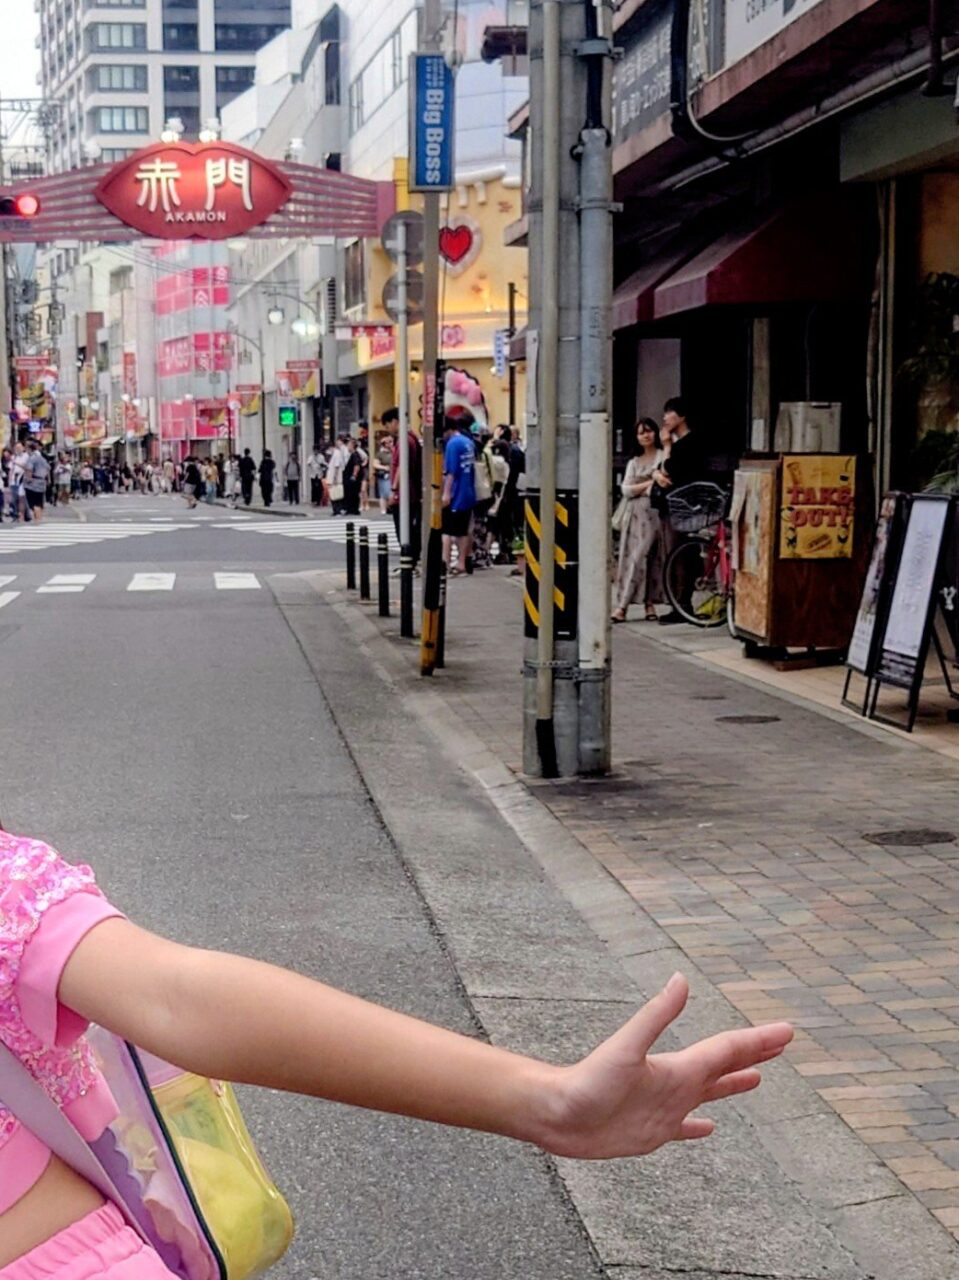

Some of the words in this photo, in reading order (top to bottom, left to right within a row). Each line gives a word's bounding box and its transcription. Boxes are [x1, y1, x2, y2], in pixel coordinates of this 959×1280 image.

[424, 89, 444, 124] Big
[426, 127, 444, 184] Boss
[135, 158, 253, 212] 赤門
[165, 211, 227, 222] AKAMON
[787, 487, 854, 506] TAKE
